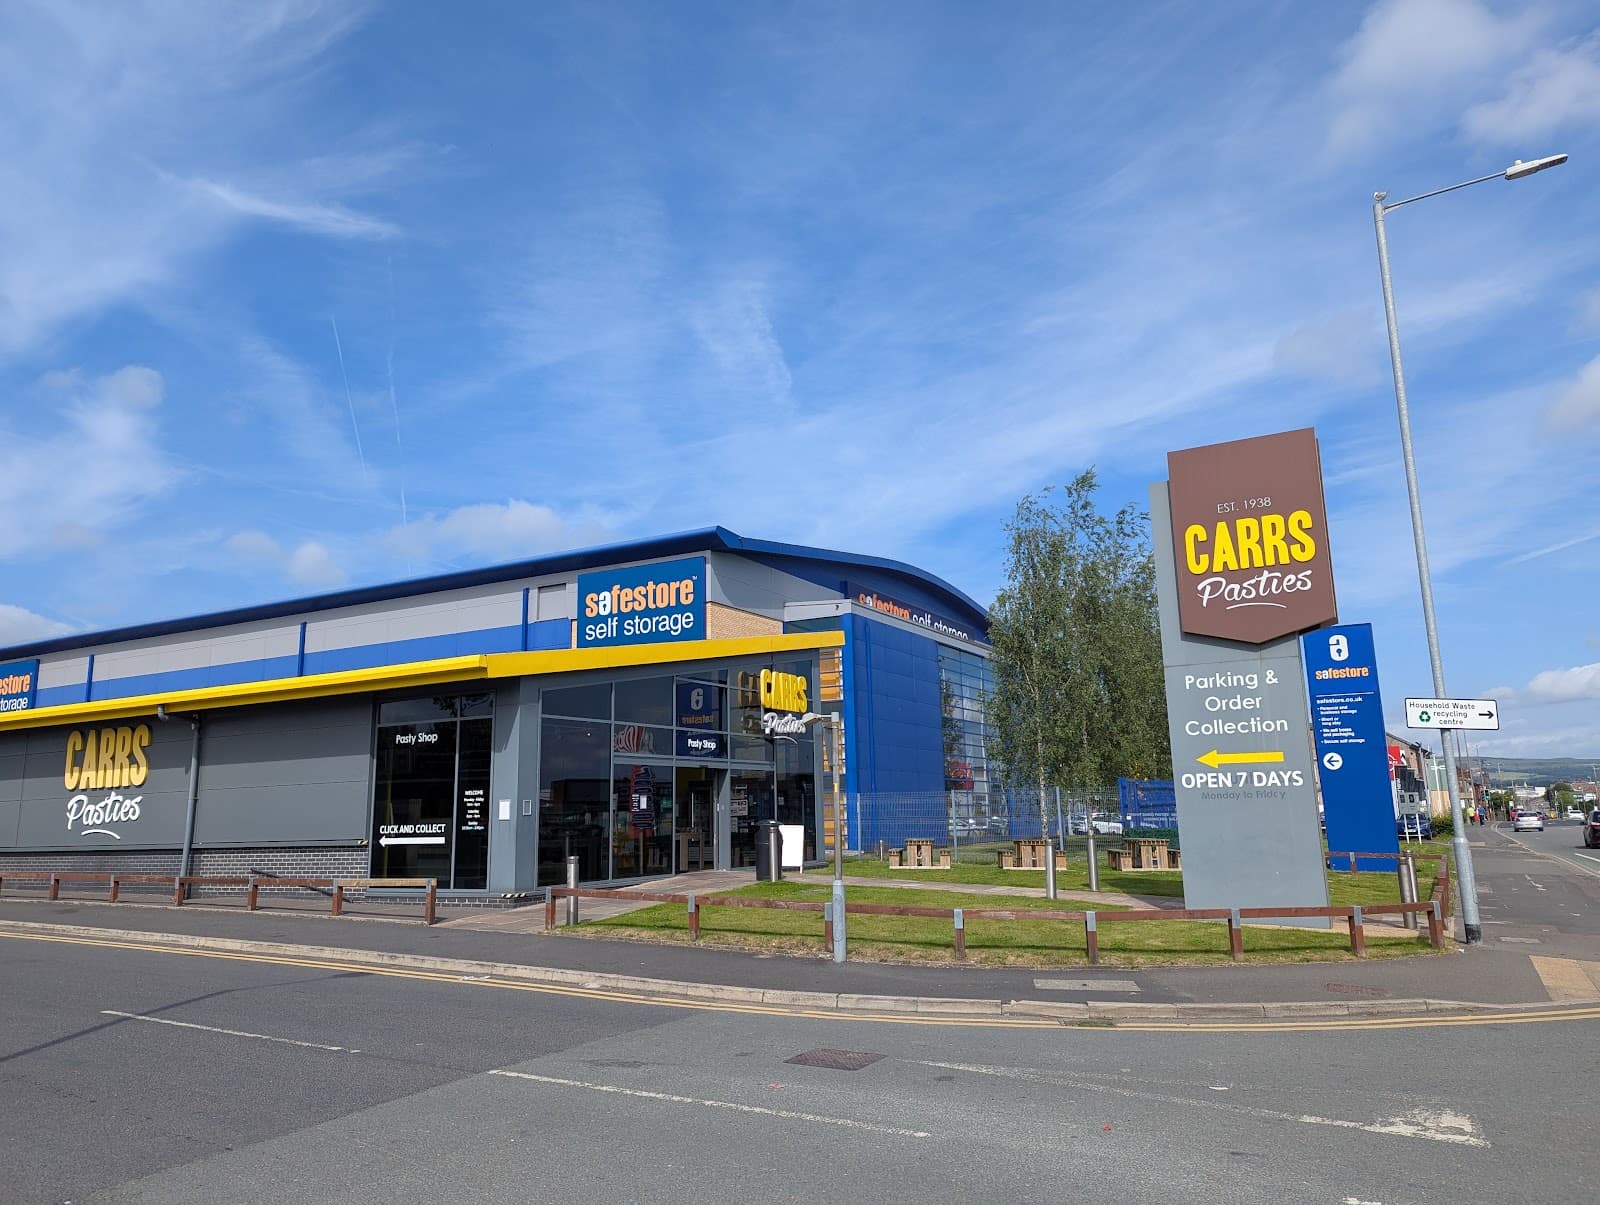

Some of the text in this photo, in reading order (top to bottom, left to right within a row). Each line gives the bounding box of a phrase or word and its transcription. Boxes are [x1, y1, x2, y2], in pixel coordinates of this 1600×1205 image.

[1217, 497, 1272, 513] EST. 1938
[1184, 510, 1316, 575] CARRS
[1196, 570, 1313, 608] Pasties
[585, 579, 694, 618] safestore
[585, 612, 694, 641] self storage
[1185, 669, 1279, 689] Parking &
[1315, 667, 1369, 680] safestore
[760, 669, 808, 713] CARRS
[1205, 695, 1262, 711] Order
[1433, 711, 1468, 719] recycling
[1185, 717, 1289, 735] Collection
[396, 732, 438, 745] Pasty Shop
[688, 739, 716, 750] Pasty Shop
[64, 723, 152, 791] CARRS
[1181, 770, 1304, 788] OPEN 7 DAYS
[67, 789, 143, 831] Pasties
[380, 824, 446, 834] CLICK AND COLLECT
